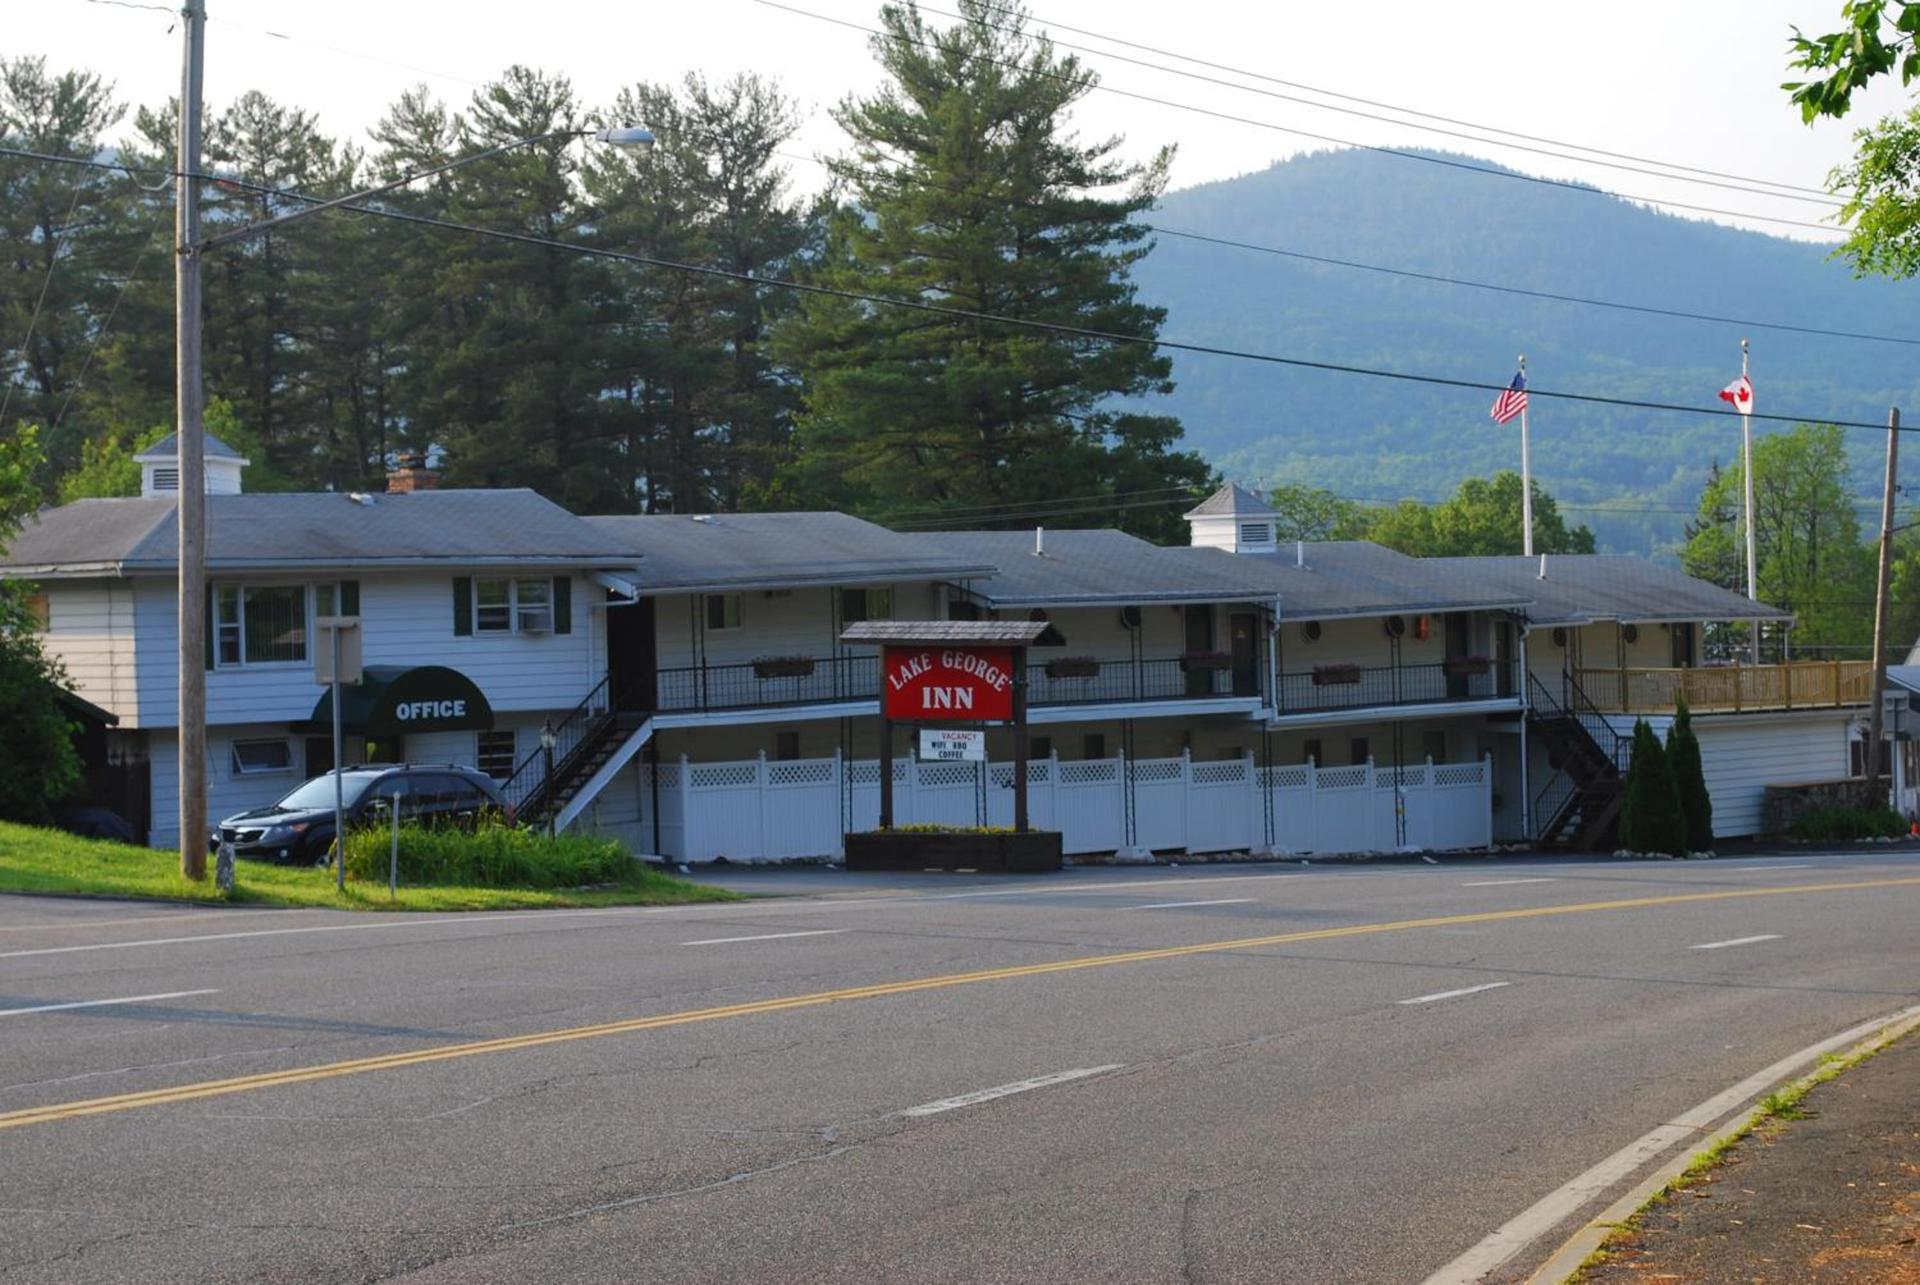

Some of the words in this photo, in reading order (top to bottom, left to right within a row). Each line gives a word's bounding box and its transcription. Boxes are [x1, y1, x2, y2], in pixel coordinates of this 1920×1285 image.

[889, 653, 932, 691] LAKE
[941, 650, 1009, 692] GEORGE
[922, 686, 973, 709] INN
[396, 700, 466, 720] OFFICE
[942, 732, 977, 741] VACANCY
[938, 750, 964, 759] COFFEE
